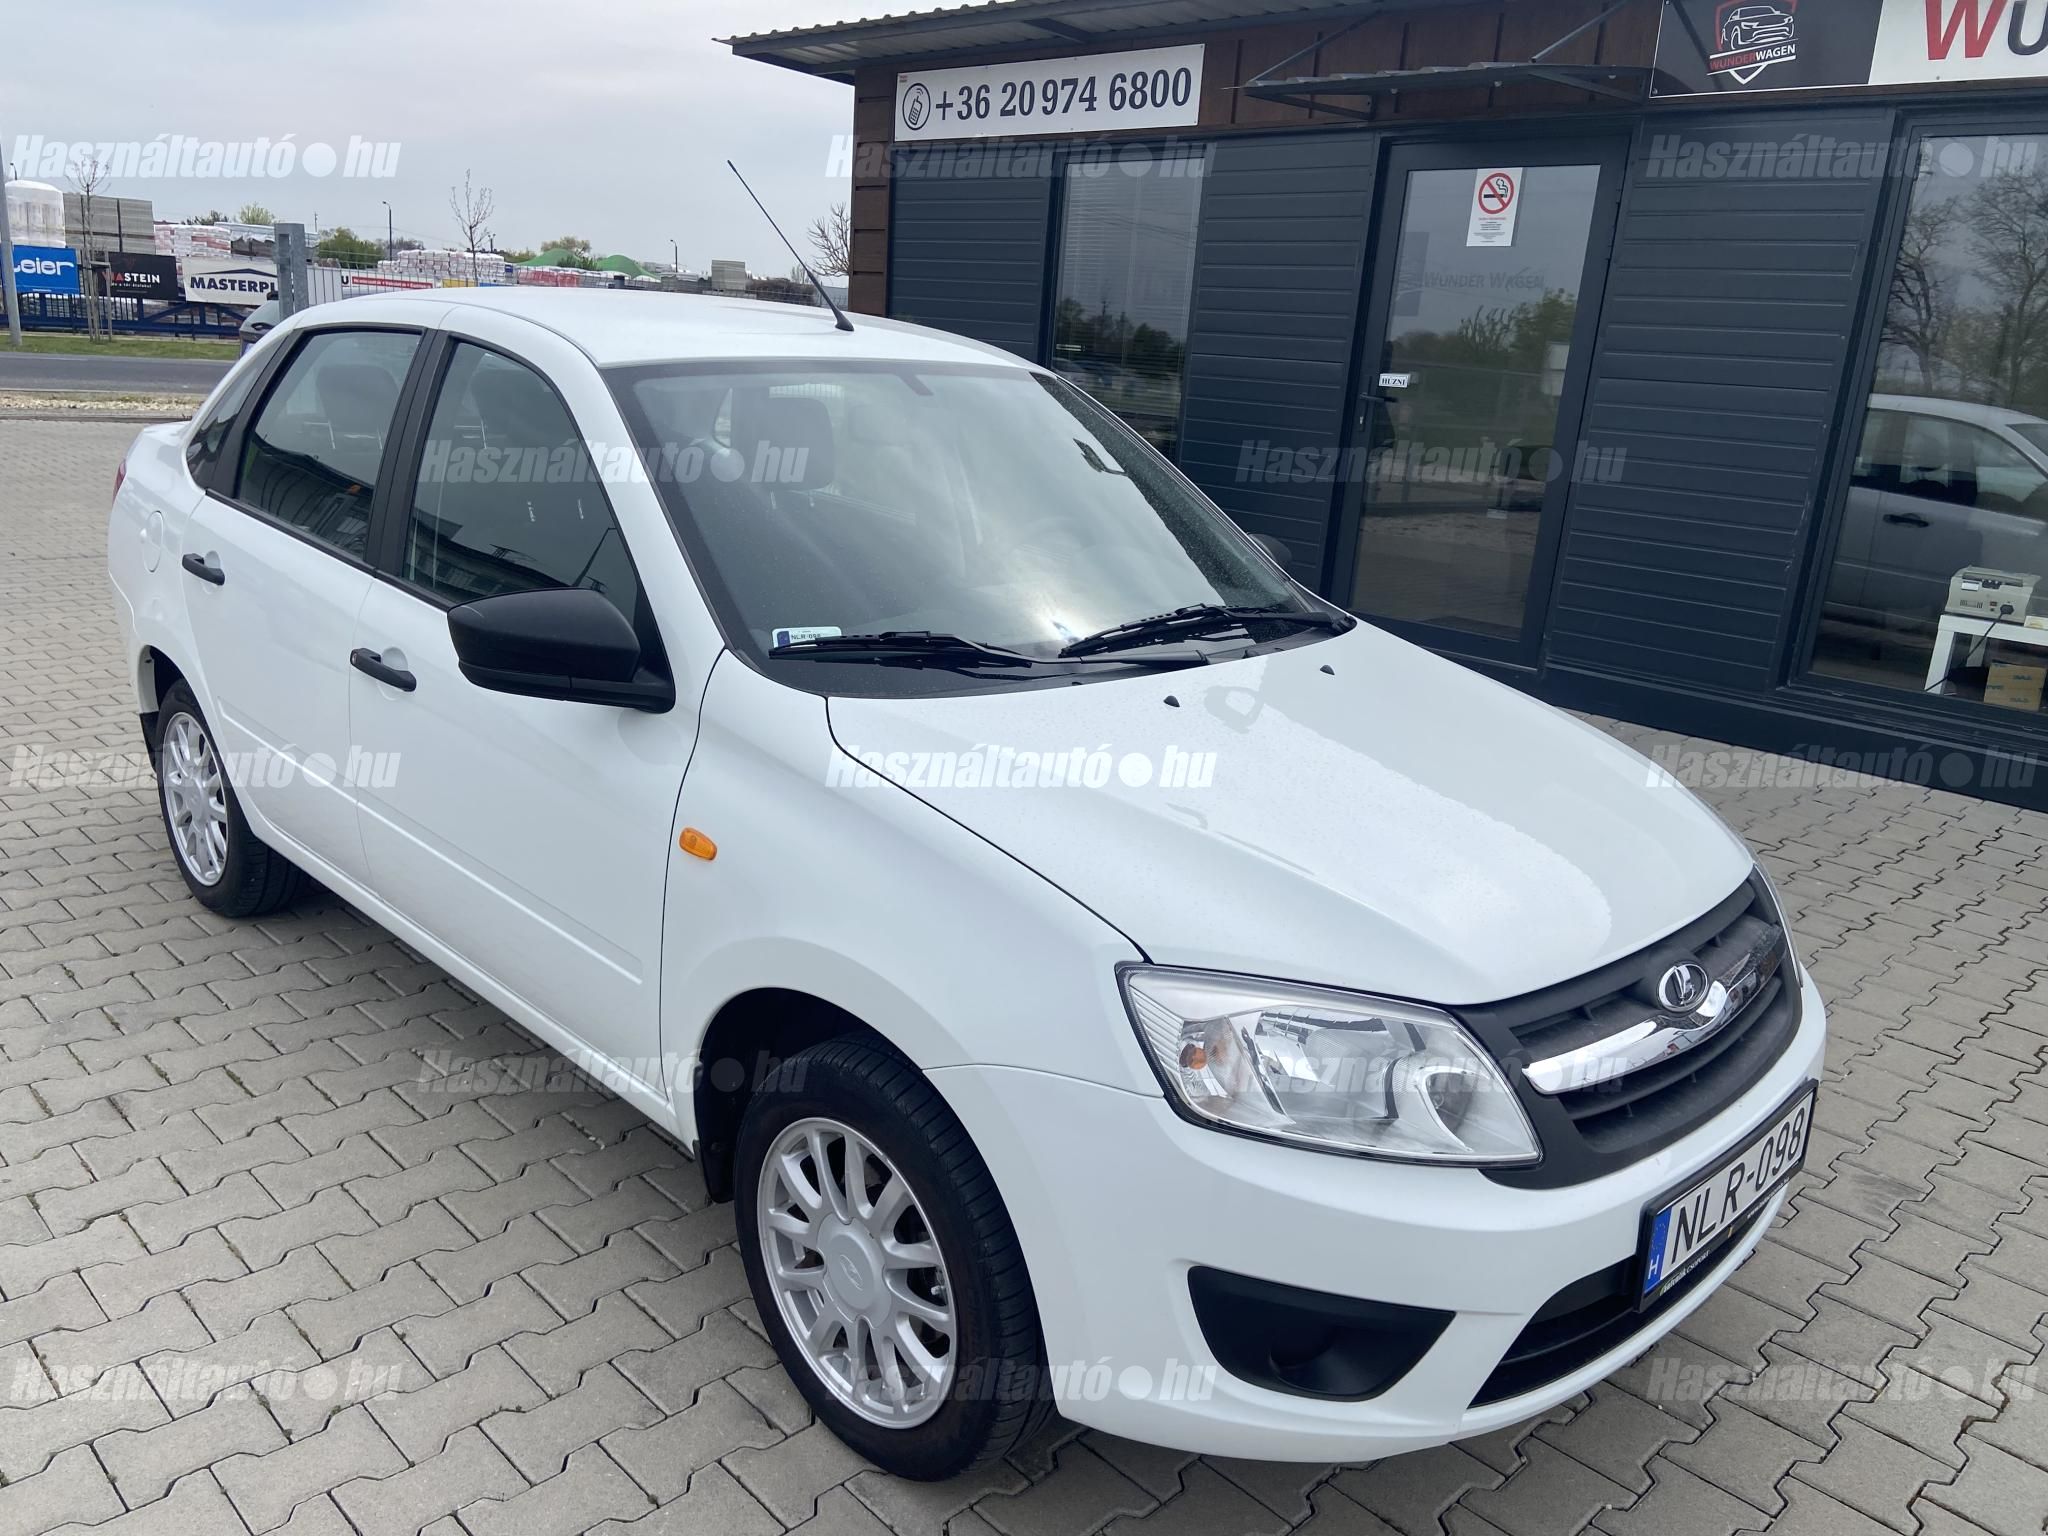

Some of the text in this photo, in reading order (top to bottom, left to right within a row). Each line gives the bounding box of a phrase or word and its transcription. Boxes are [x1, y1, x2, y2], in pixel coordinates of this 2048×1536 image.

[936, 67, 1192, 121] +36 20 974 6800
[14, 257, 74, 275] eier
[1671, 1107, 1805, 1265] NLR-098
